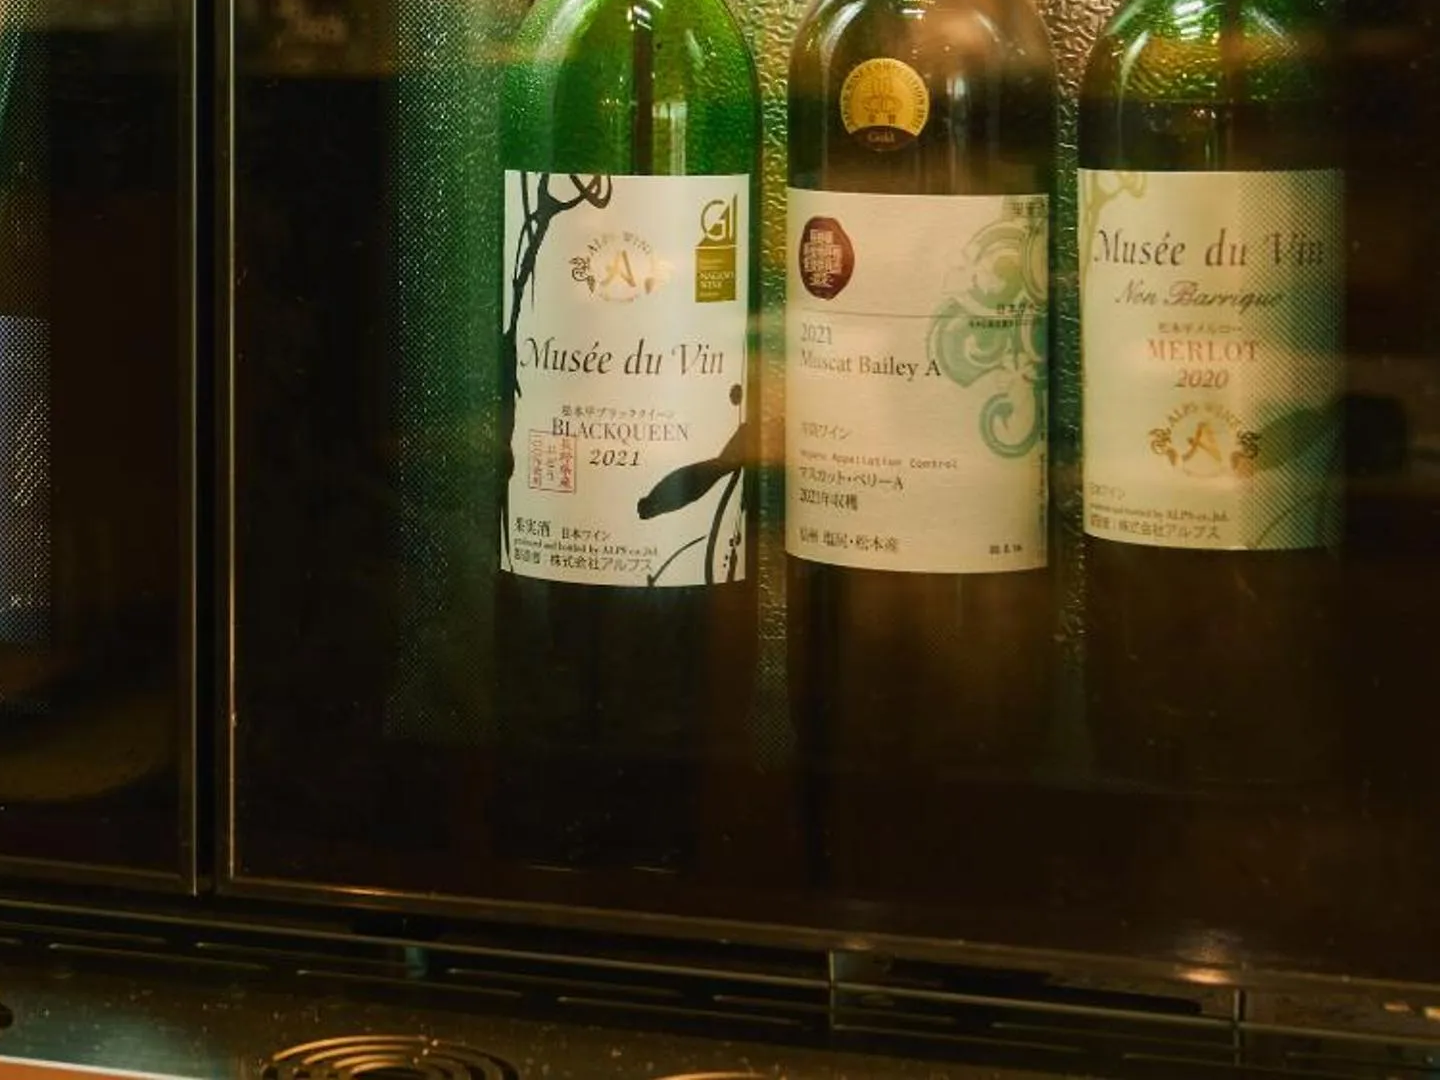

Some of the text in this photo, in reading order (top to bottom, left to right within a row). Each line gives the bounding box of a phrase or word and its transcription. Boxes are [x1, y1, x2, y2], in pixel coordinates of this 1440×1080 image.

[1093, 227, 1187, 266] Musée
[1204, 227, 1248, 267] du
[800, 323, 833, 345] 2021
[520, 337, 725, 376] Musée du Vin
[1146, 338, 1258, 362] MERLOT
[858, 355, 920, 381] Bailey
[924, 358, 942, 377] A
[1174, 369, 1229, 389] 2020
[551, 417, 691, 447] BLACKQUEEN
[589, 448, 641, 467] 2021
